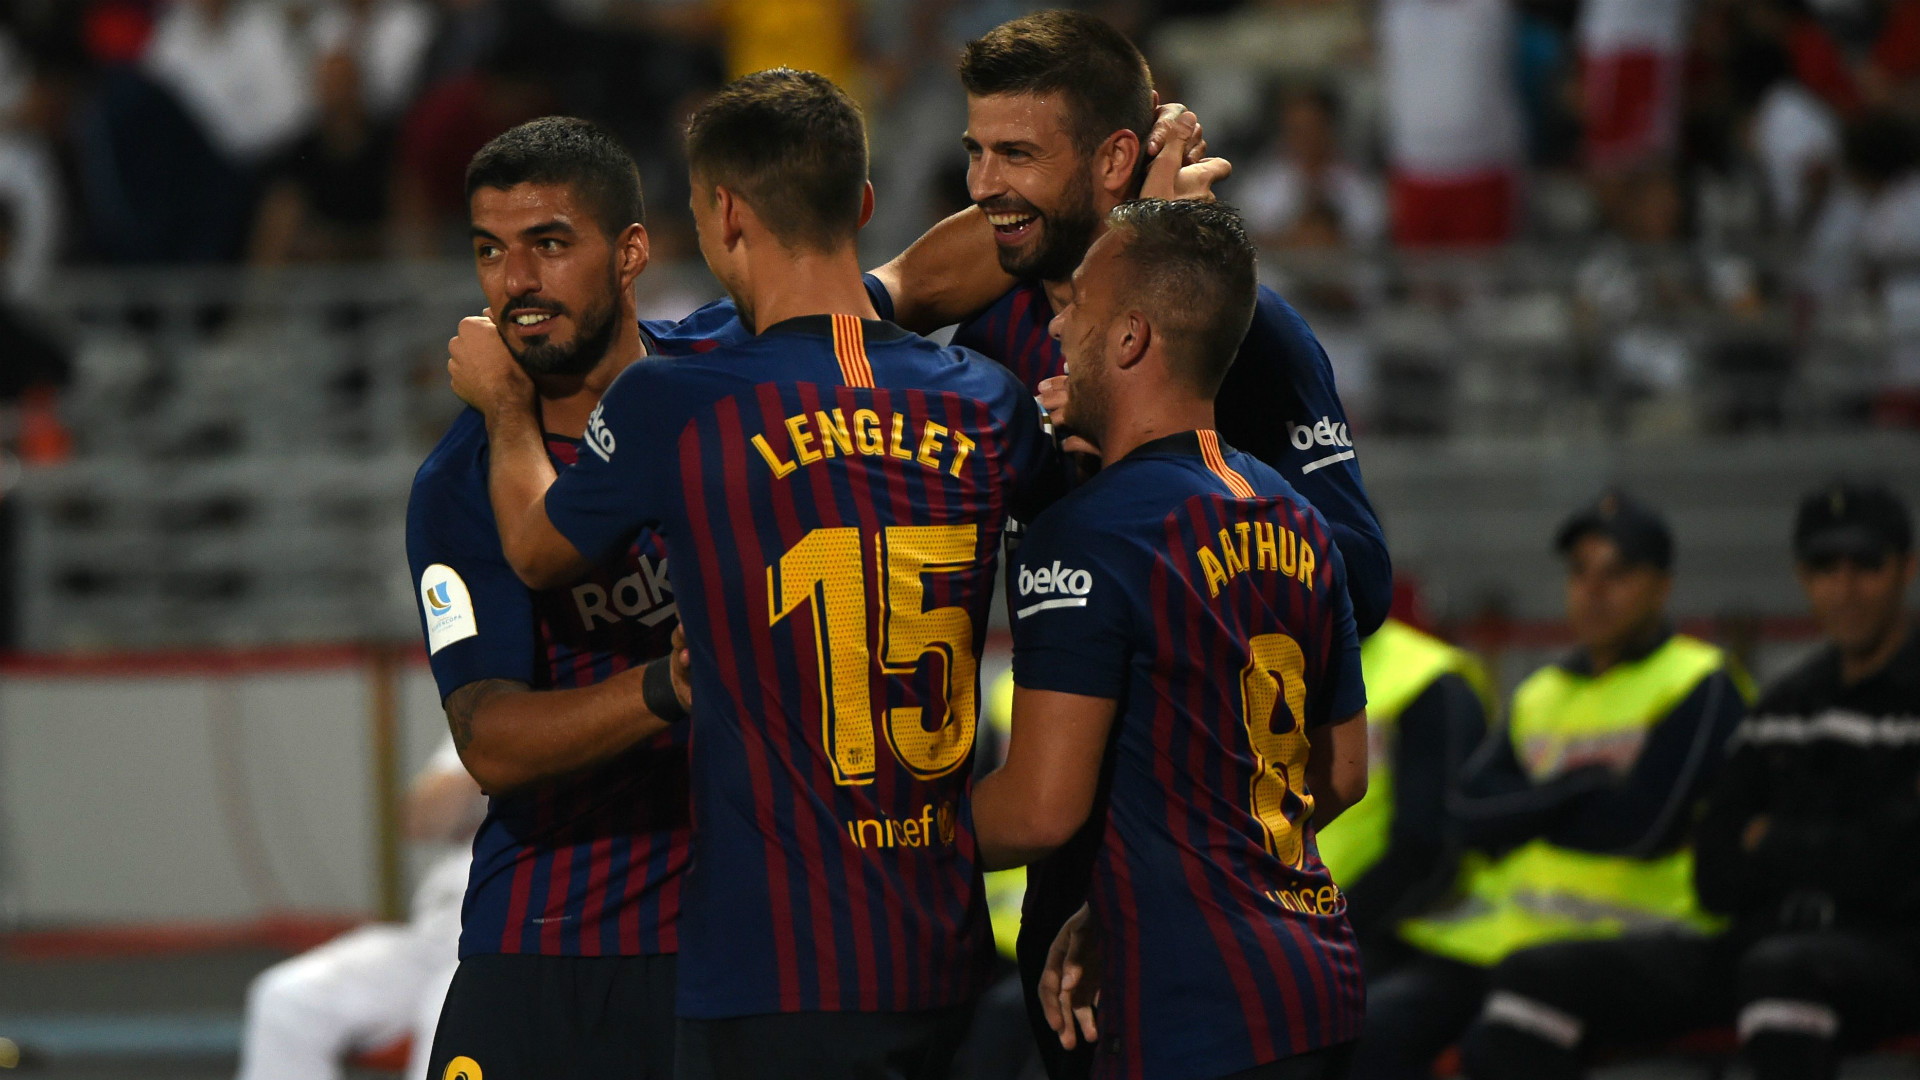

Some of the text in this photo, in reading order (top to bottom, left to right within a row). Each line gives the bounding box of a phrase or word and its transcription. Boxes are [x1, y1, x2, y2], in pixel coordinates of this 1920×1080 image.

[588, 400, 616, 454] eko
[751, 408, 976, 480] LENGLET
[1018, 561, 1093, 597] beko
[1196, 521, 1315, 598] ARTHUR
[766, 524, 978, 786] 15
[1240, 633, 1315, 870] 8
[1265, 881, 1338, 916] unice
